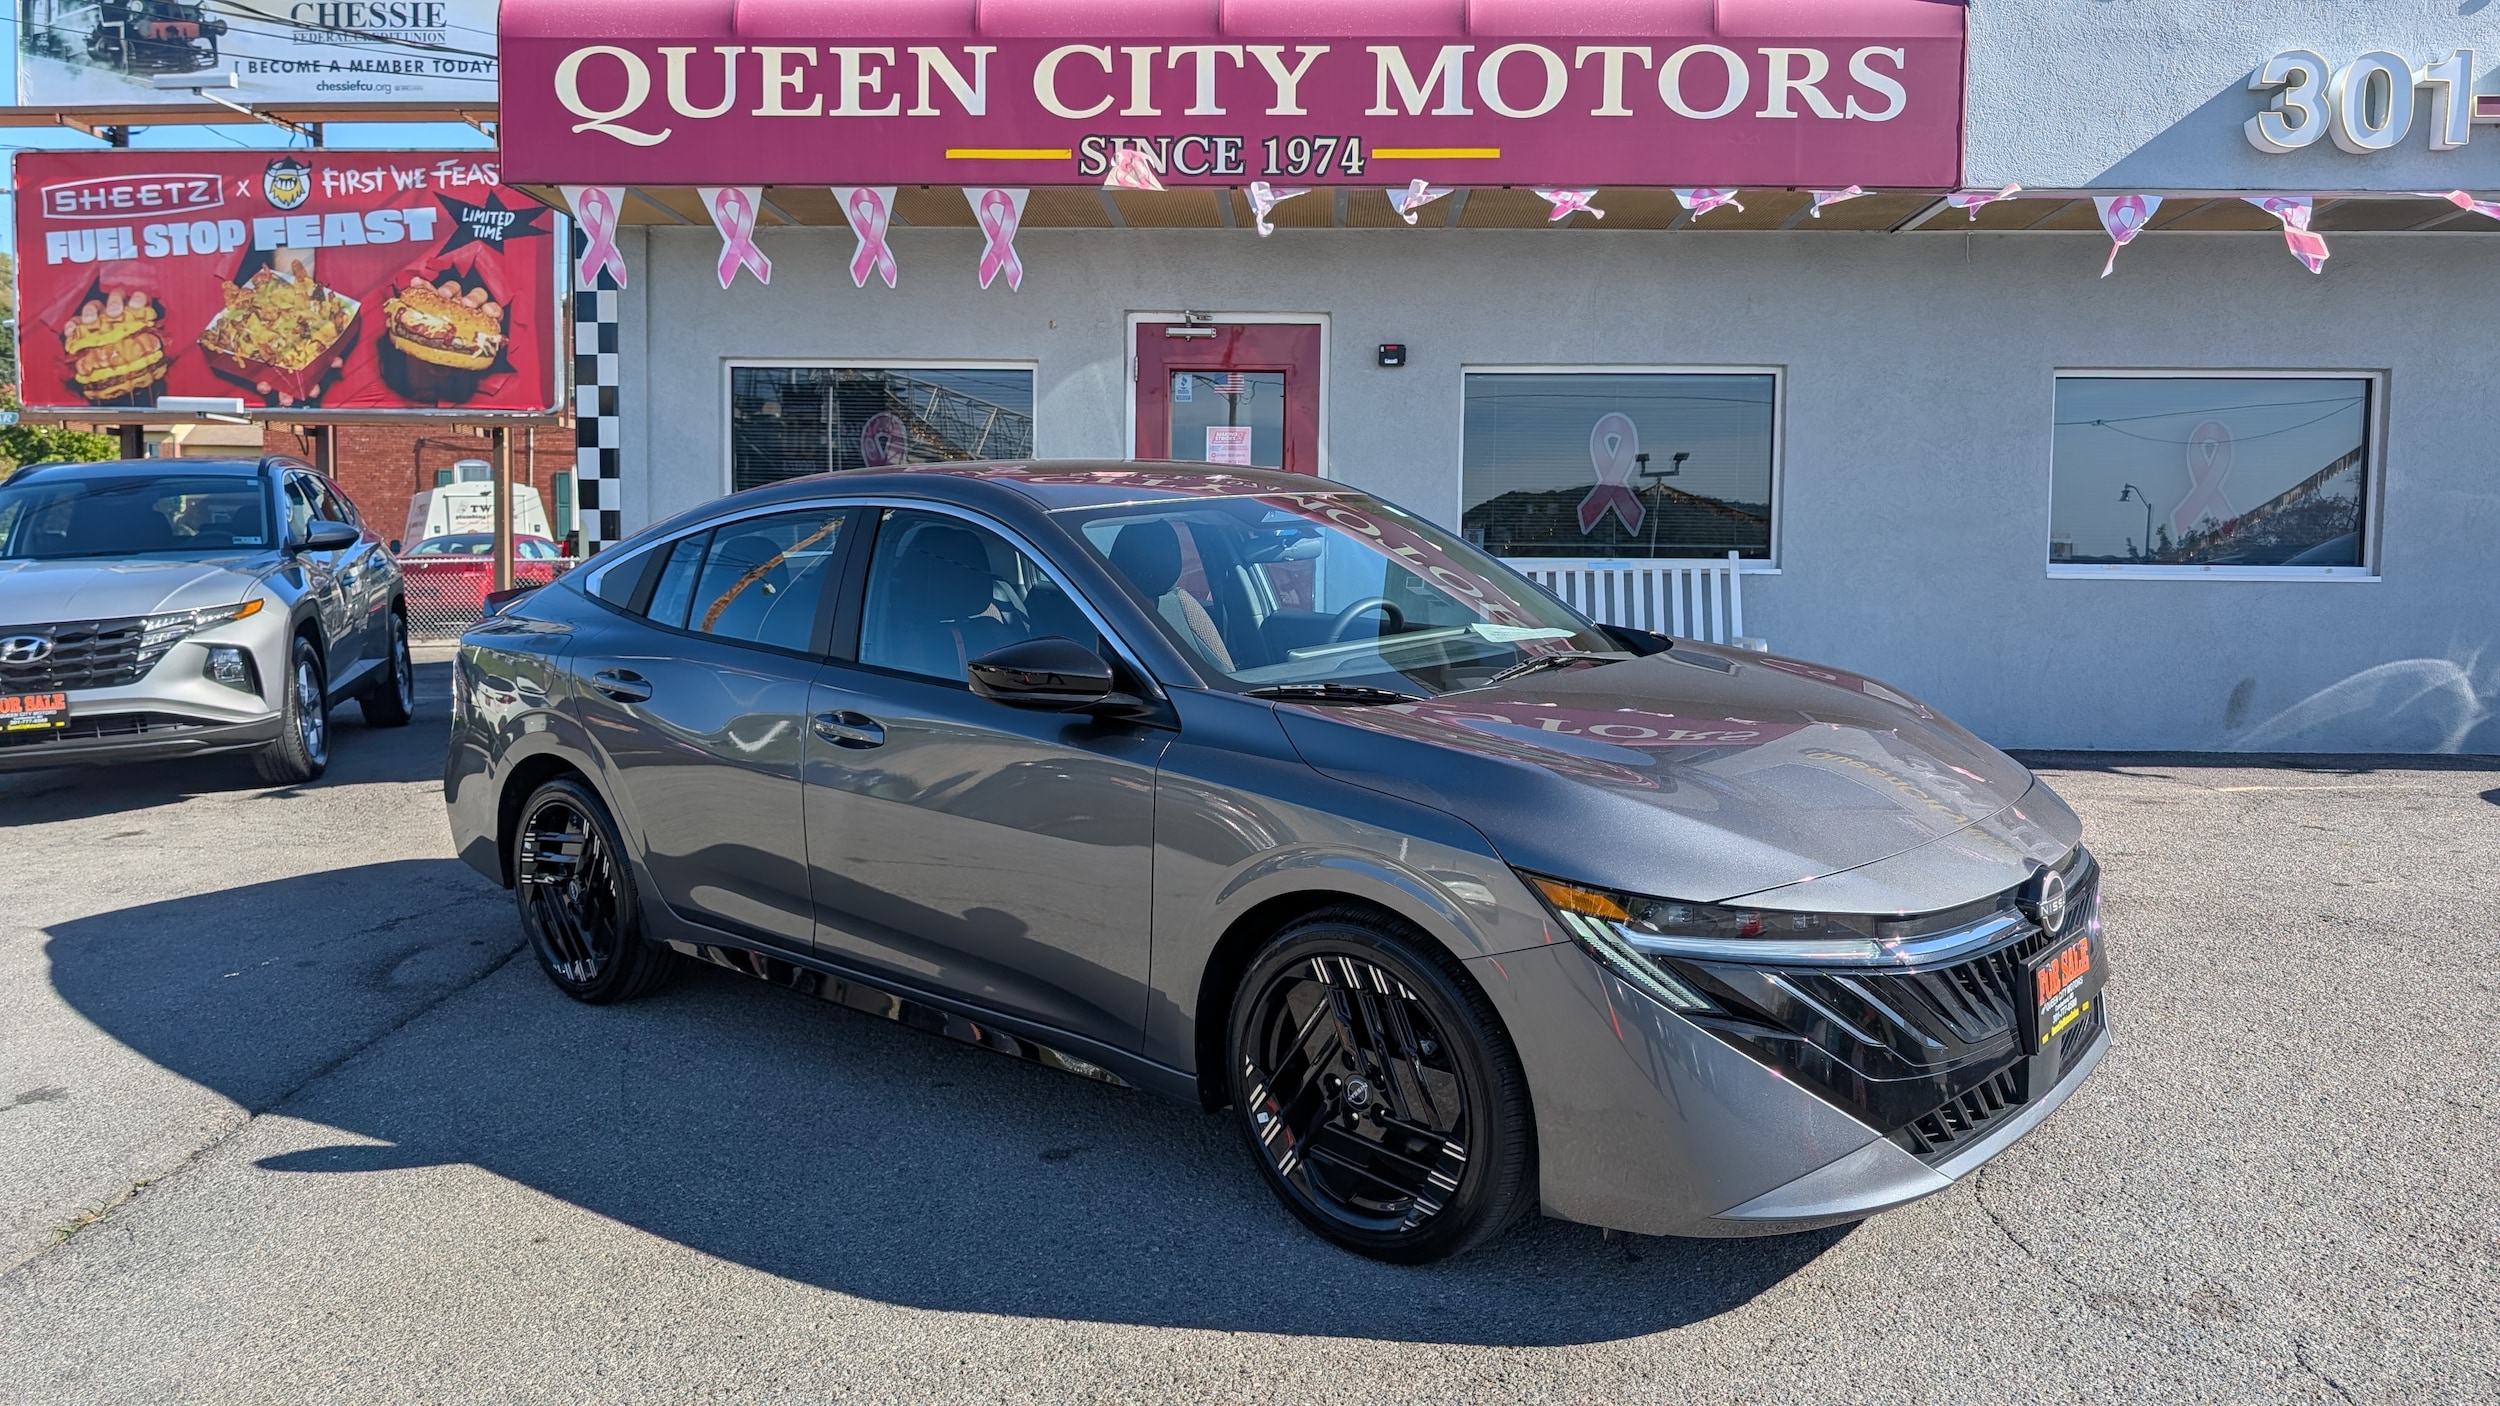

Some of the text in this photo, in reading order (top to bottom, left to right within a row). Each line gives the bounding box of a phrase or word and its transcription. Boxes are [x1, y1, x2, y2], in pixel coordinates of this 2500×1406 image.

[291, 2, 447, 28] CHESSIE
[293, 32, 351, 43] FEDERAL
[405, 32, 446, 42] UNION
[248, 60, 493, 74] BECOME A MEMBER TODAY
[316, 80, 392, 94] chessiefcu.org
[553, 43, 1908, 147] QUEEN CITY MOTORS
[1262, 135, 1366, 176] 1974
[55, 180, 210, 212] SHEETZ
[322, 164, 386, 198] FIRST
[390, 164, 428, 191] WE
[462, 207, 516, 227] LIMITED
[46, 207, 438, 265] FUEL STOP FEAST
[472, 225, 503, 241] TIME
[24, 694, 66, 712] SALE
[2041, 896, 2065, 916] NISS
[2038, 958, 2061, 1007] FOR
[2061, 937, 2090, 987] SALE
